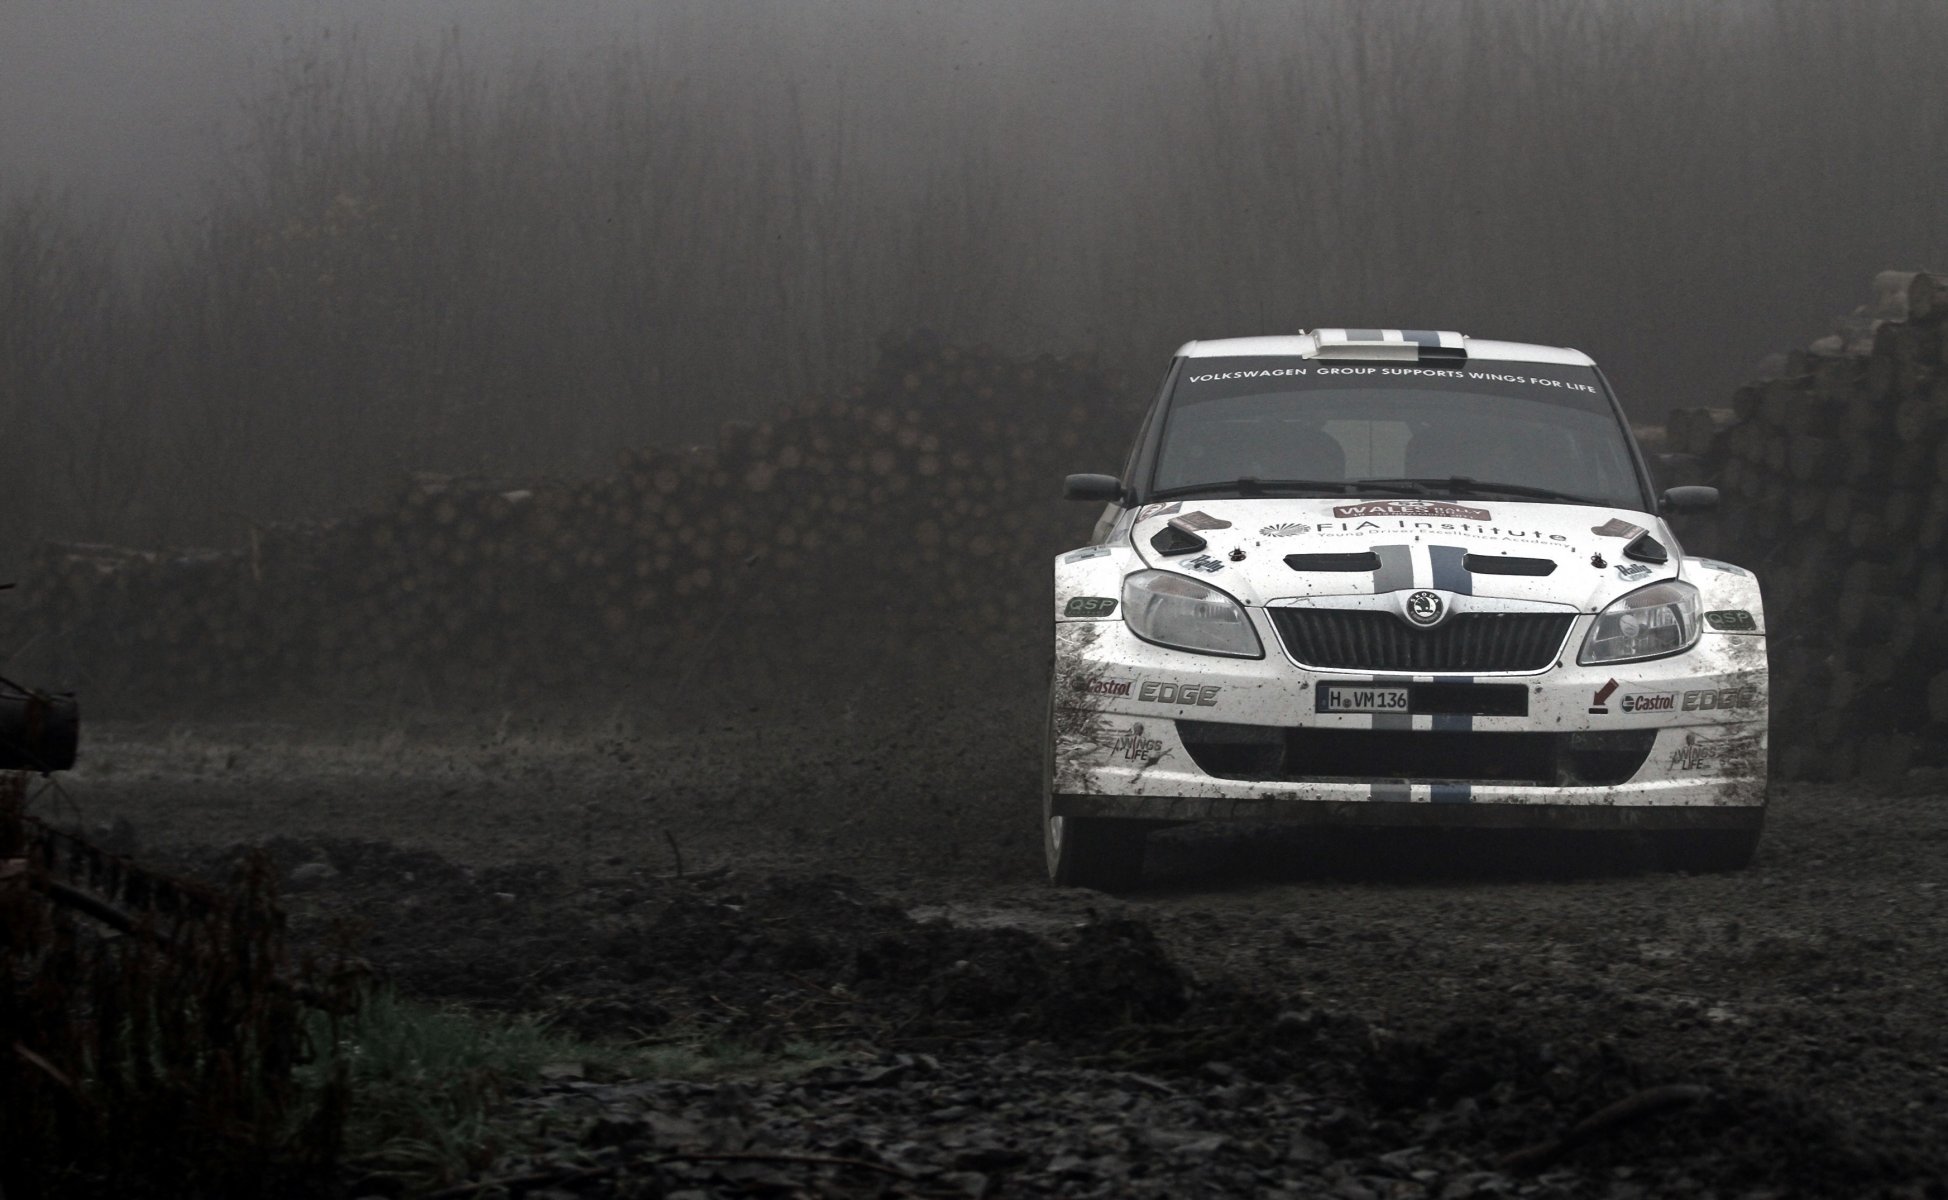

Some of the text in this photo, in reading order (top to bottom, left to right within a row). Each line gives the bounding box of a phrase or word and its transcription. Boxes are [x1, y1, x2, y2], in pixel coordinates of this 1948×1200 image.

[1189, 367, 1596, 394] VOLKSWAGEN GROUP SUPPORTS WINGS FOR LIFE
[1339, 505, 1429, 515] WALES
[1317, 520, 1567, 541] FIA Institute
[1070, 599, 1114, 610] QSP
[1708, 612, 1749, 624] QSP
[1086, 678, 1222, 707] Castrol EDGE
[1634, 687, 1757, 711] Castrol EDGE
